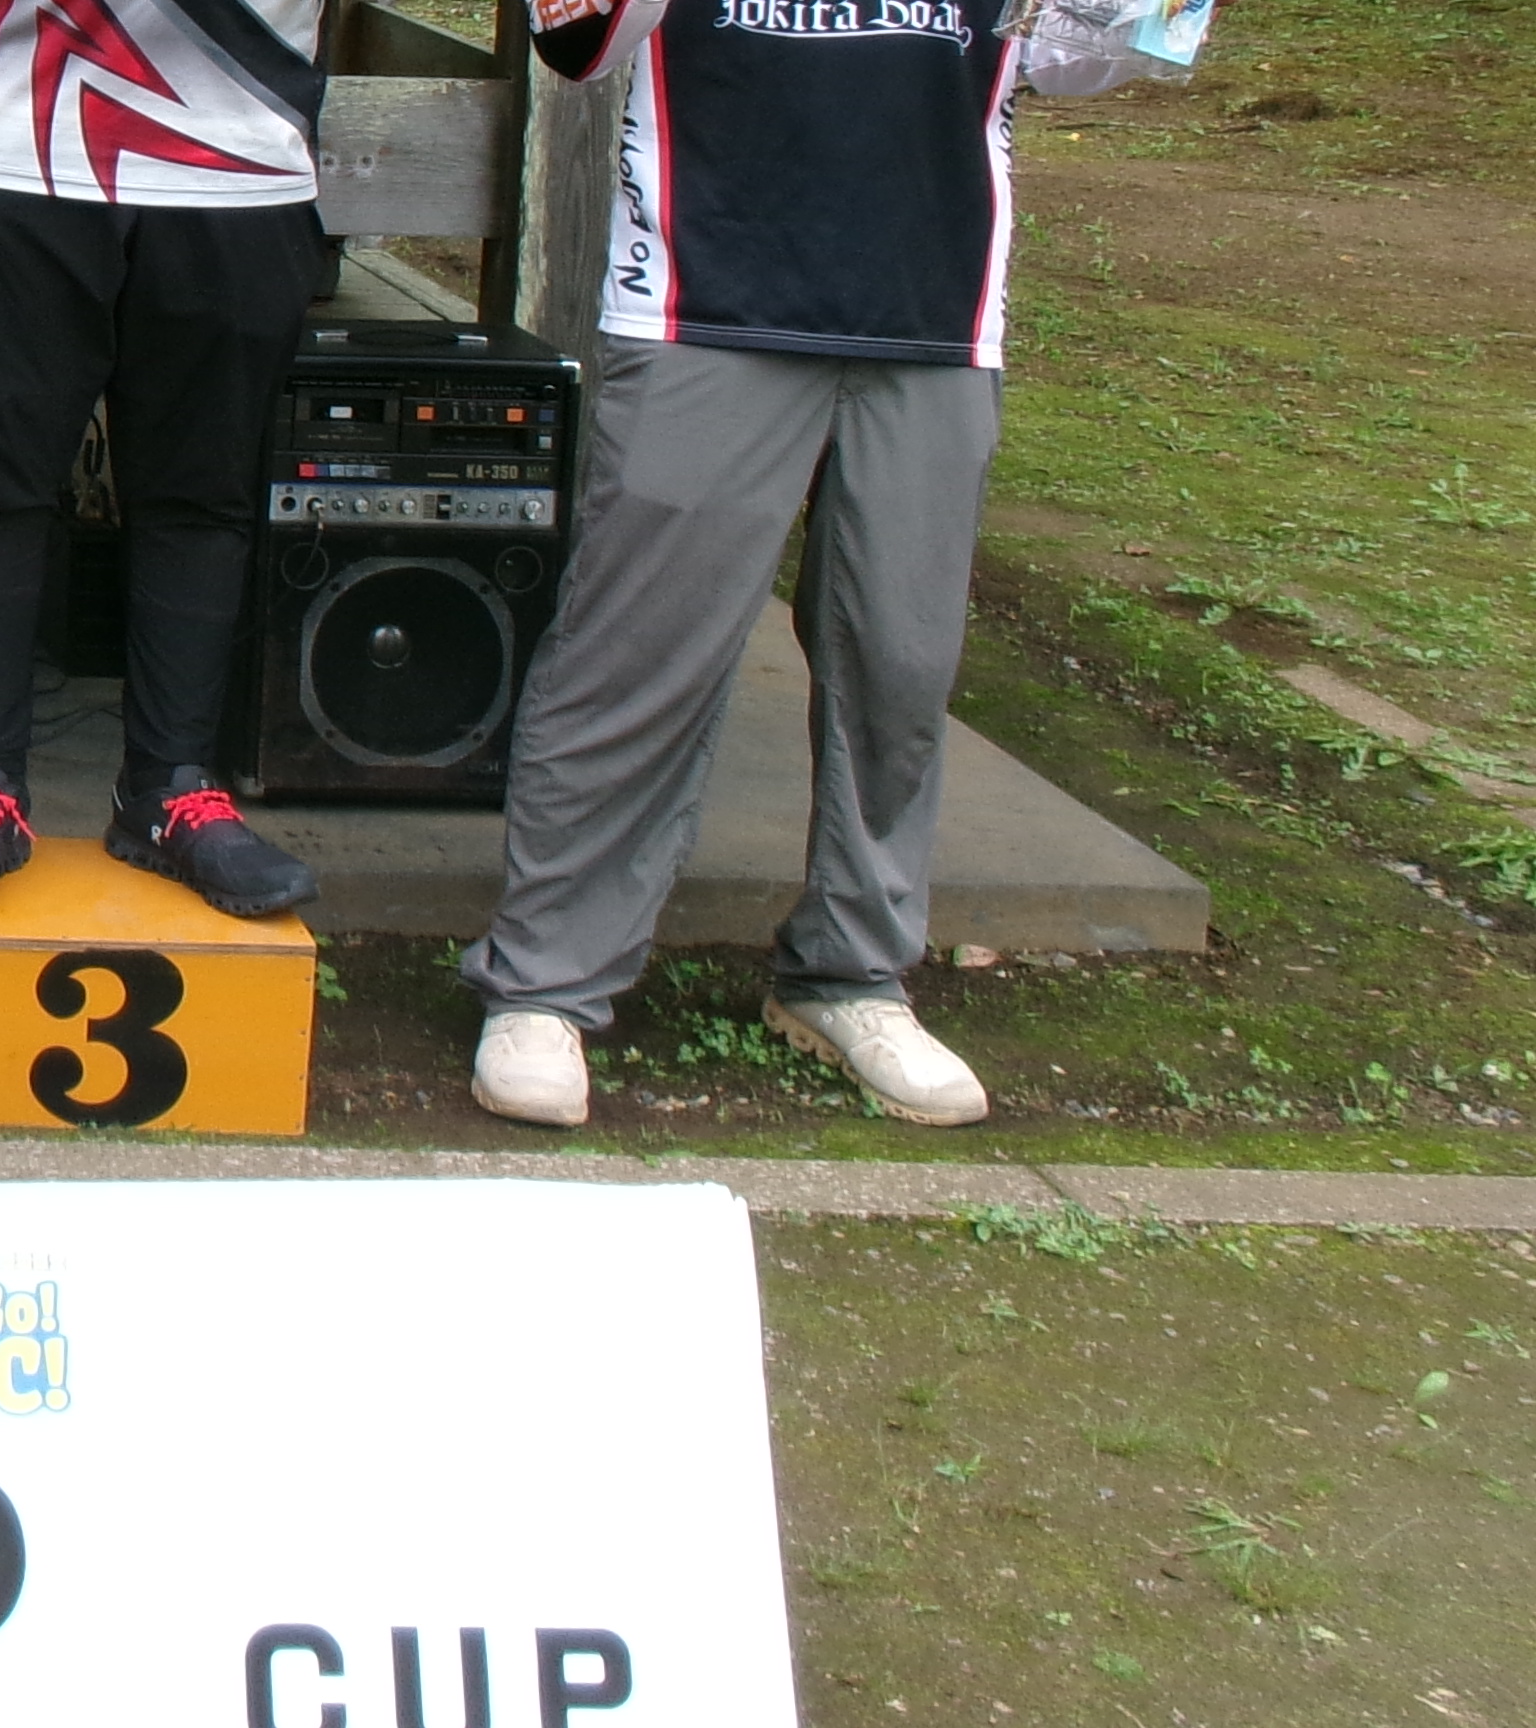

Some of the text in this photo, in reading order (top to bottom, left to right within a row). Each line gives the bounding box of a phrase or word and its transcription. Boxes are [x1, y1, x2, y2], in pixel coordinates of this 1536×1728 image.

[466, 464, 518, 480] KA-350
[29, 948, 188, 1129] 3
[245, 1623, 632, 1728] CUP
